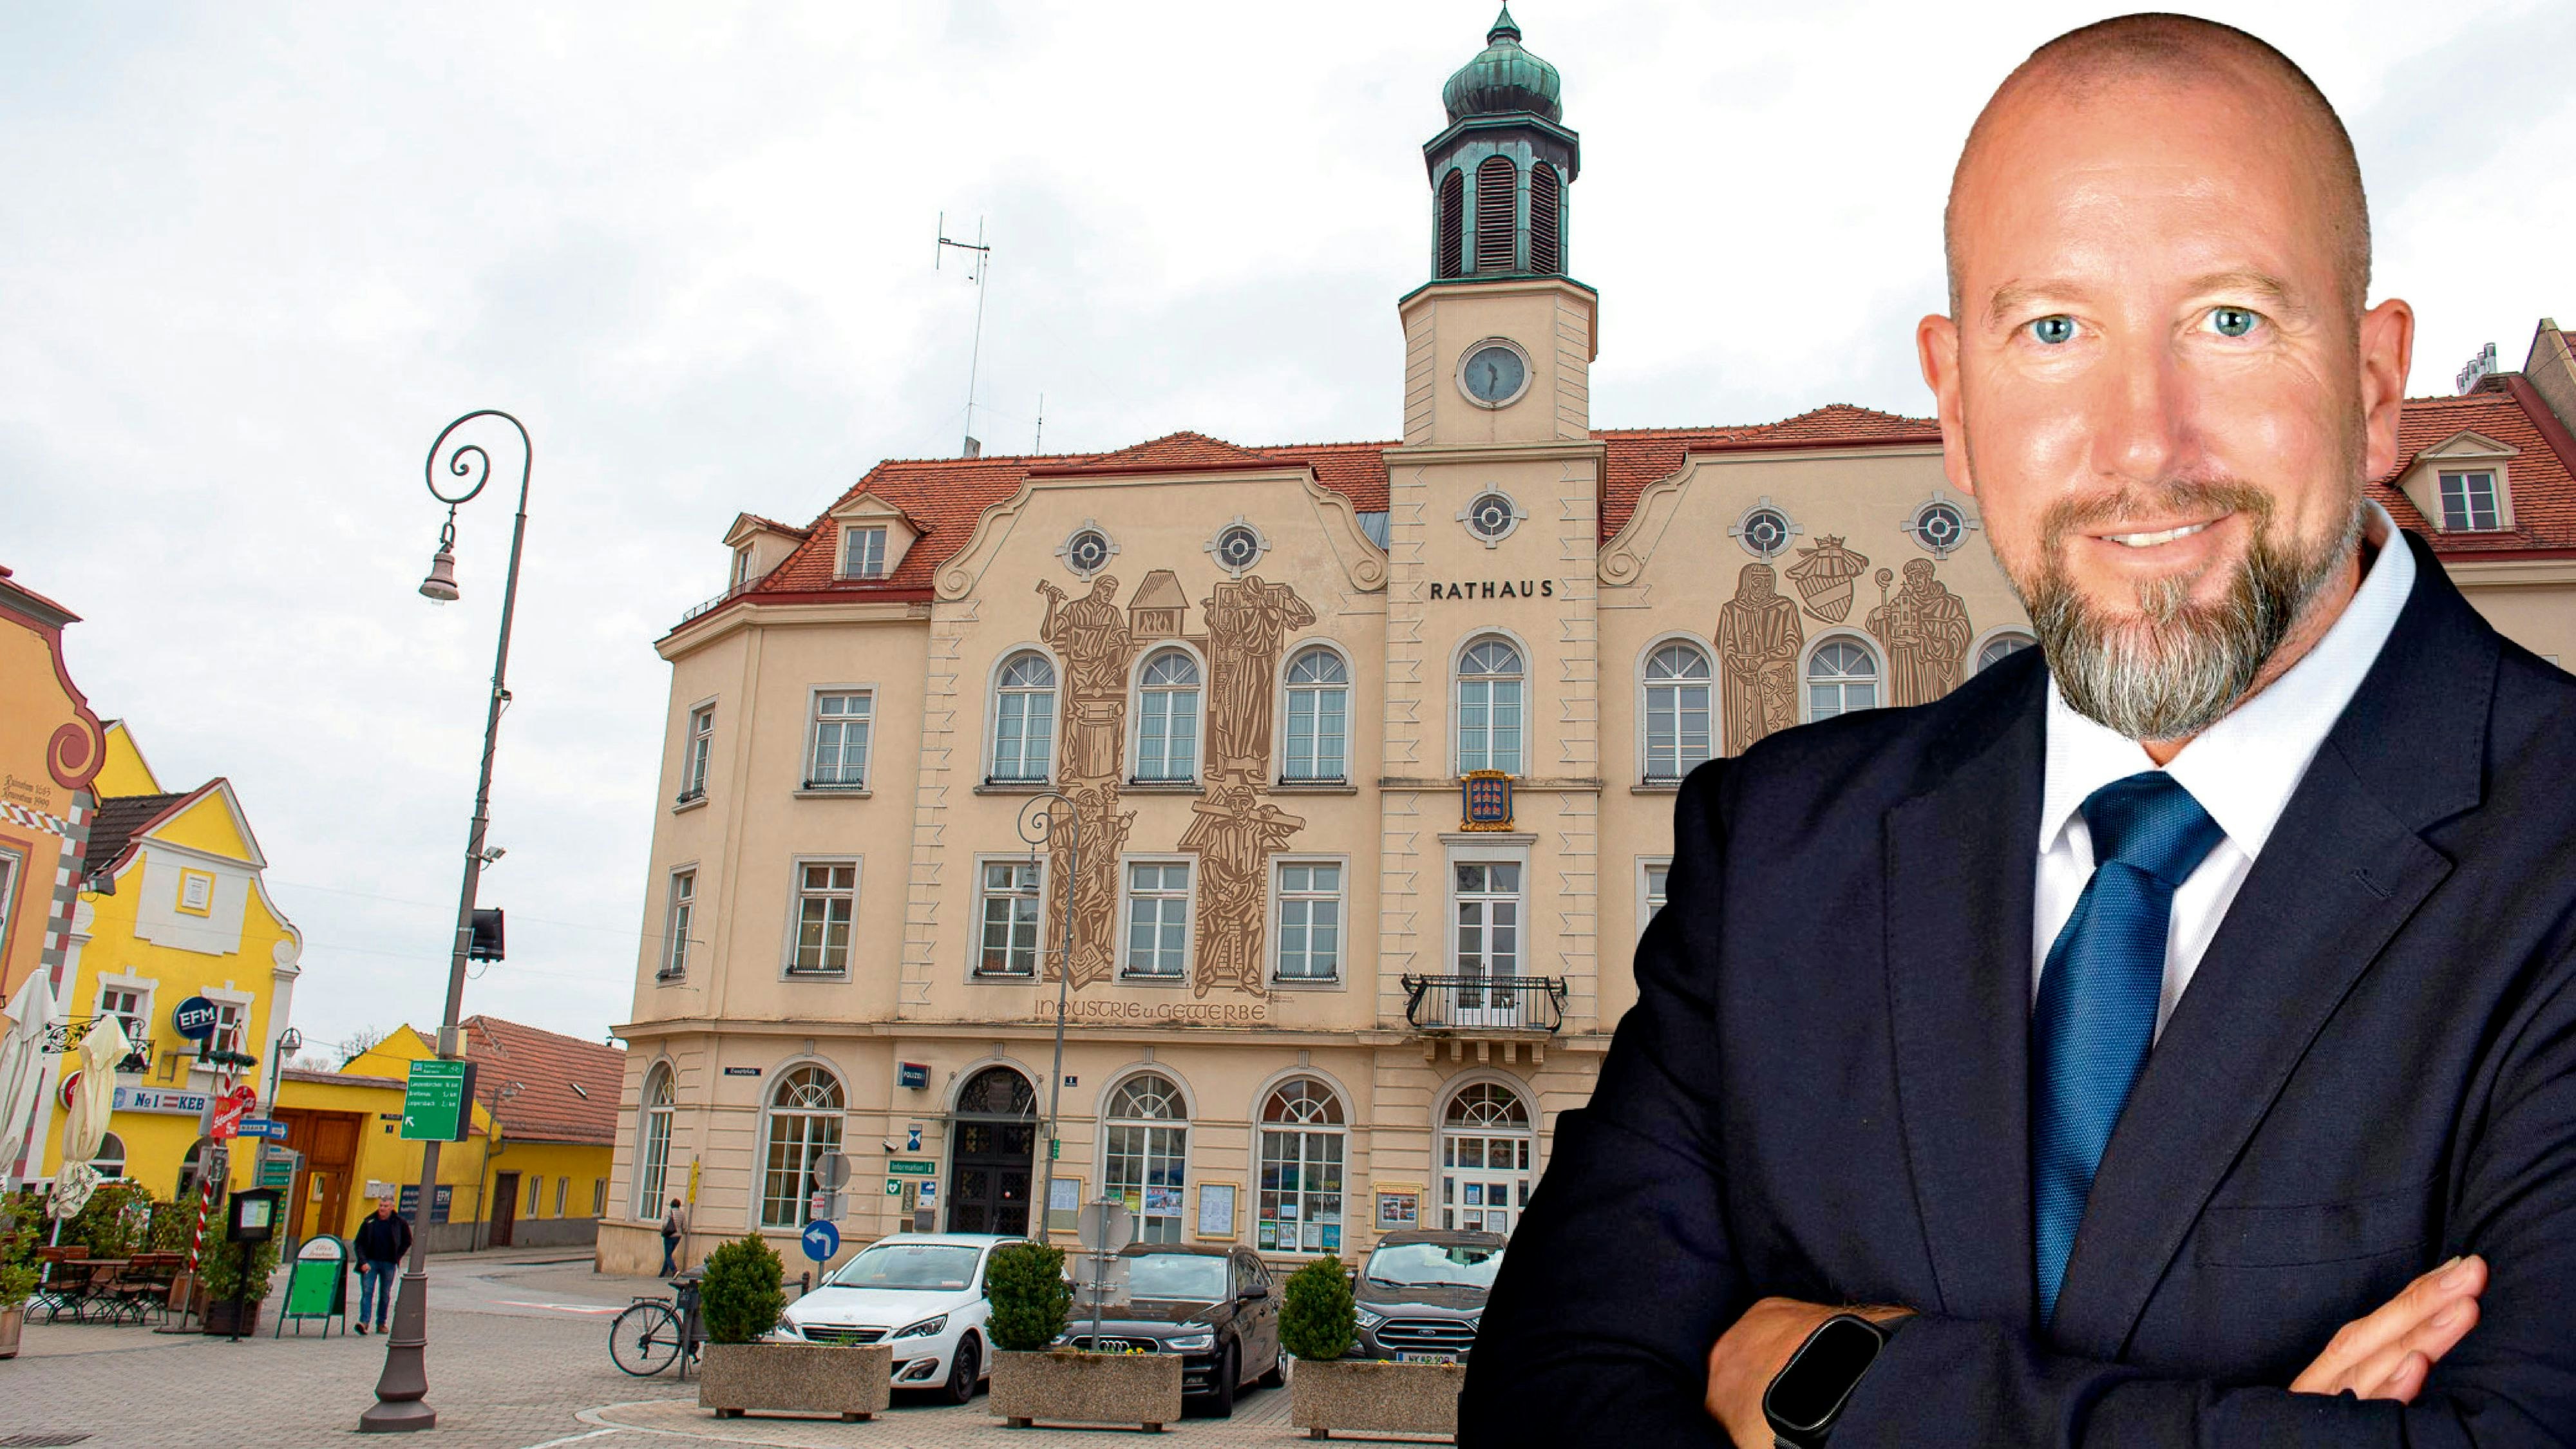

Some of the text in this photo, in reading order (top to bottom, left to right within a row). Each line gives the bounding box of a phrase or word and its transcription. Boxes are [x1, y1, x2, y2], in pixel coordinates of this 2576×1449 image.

[1430, 580, 1553, 600] RATHAUS
[178, 1007, 216, 1027] EFM
[1158, 1003, 1265, 1020] GEWERBE
[891, 1162, 924, 1172] Information
